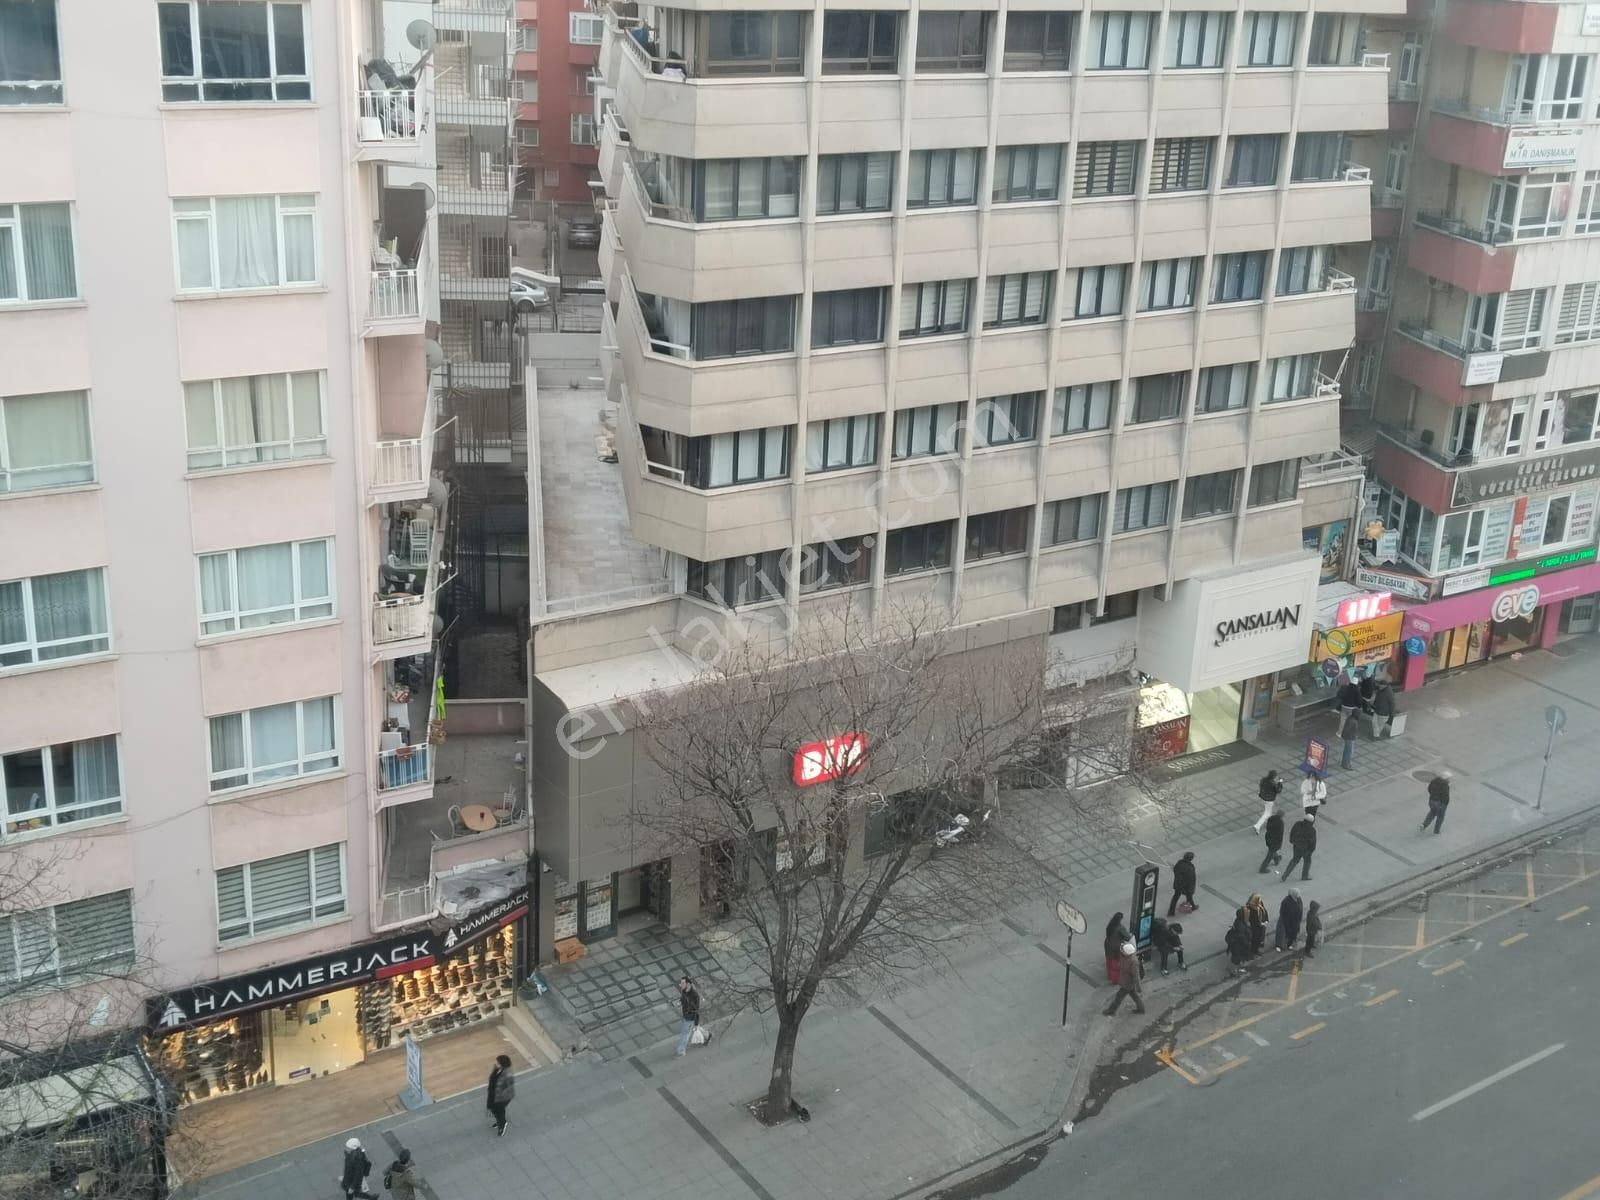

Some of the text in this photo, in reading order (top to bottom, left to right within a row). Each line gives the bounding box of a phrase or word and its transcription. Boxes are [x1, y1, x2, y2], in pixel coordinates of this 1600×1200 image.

[1214, 604, 1301, 647] SANSALAN
[1496, 587, 1539, 620] eve
[460, 891, 529, 936] HAMMERJACK
[194, 940, 430, 1014] HAMMERJACK
